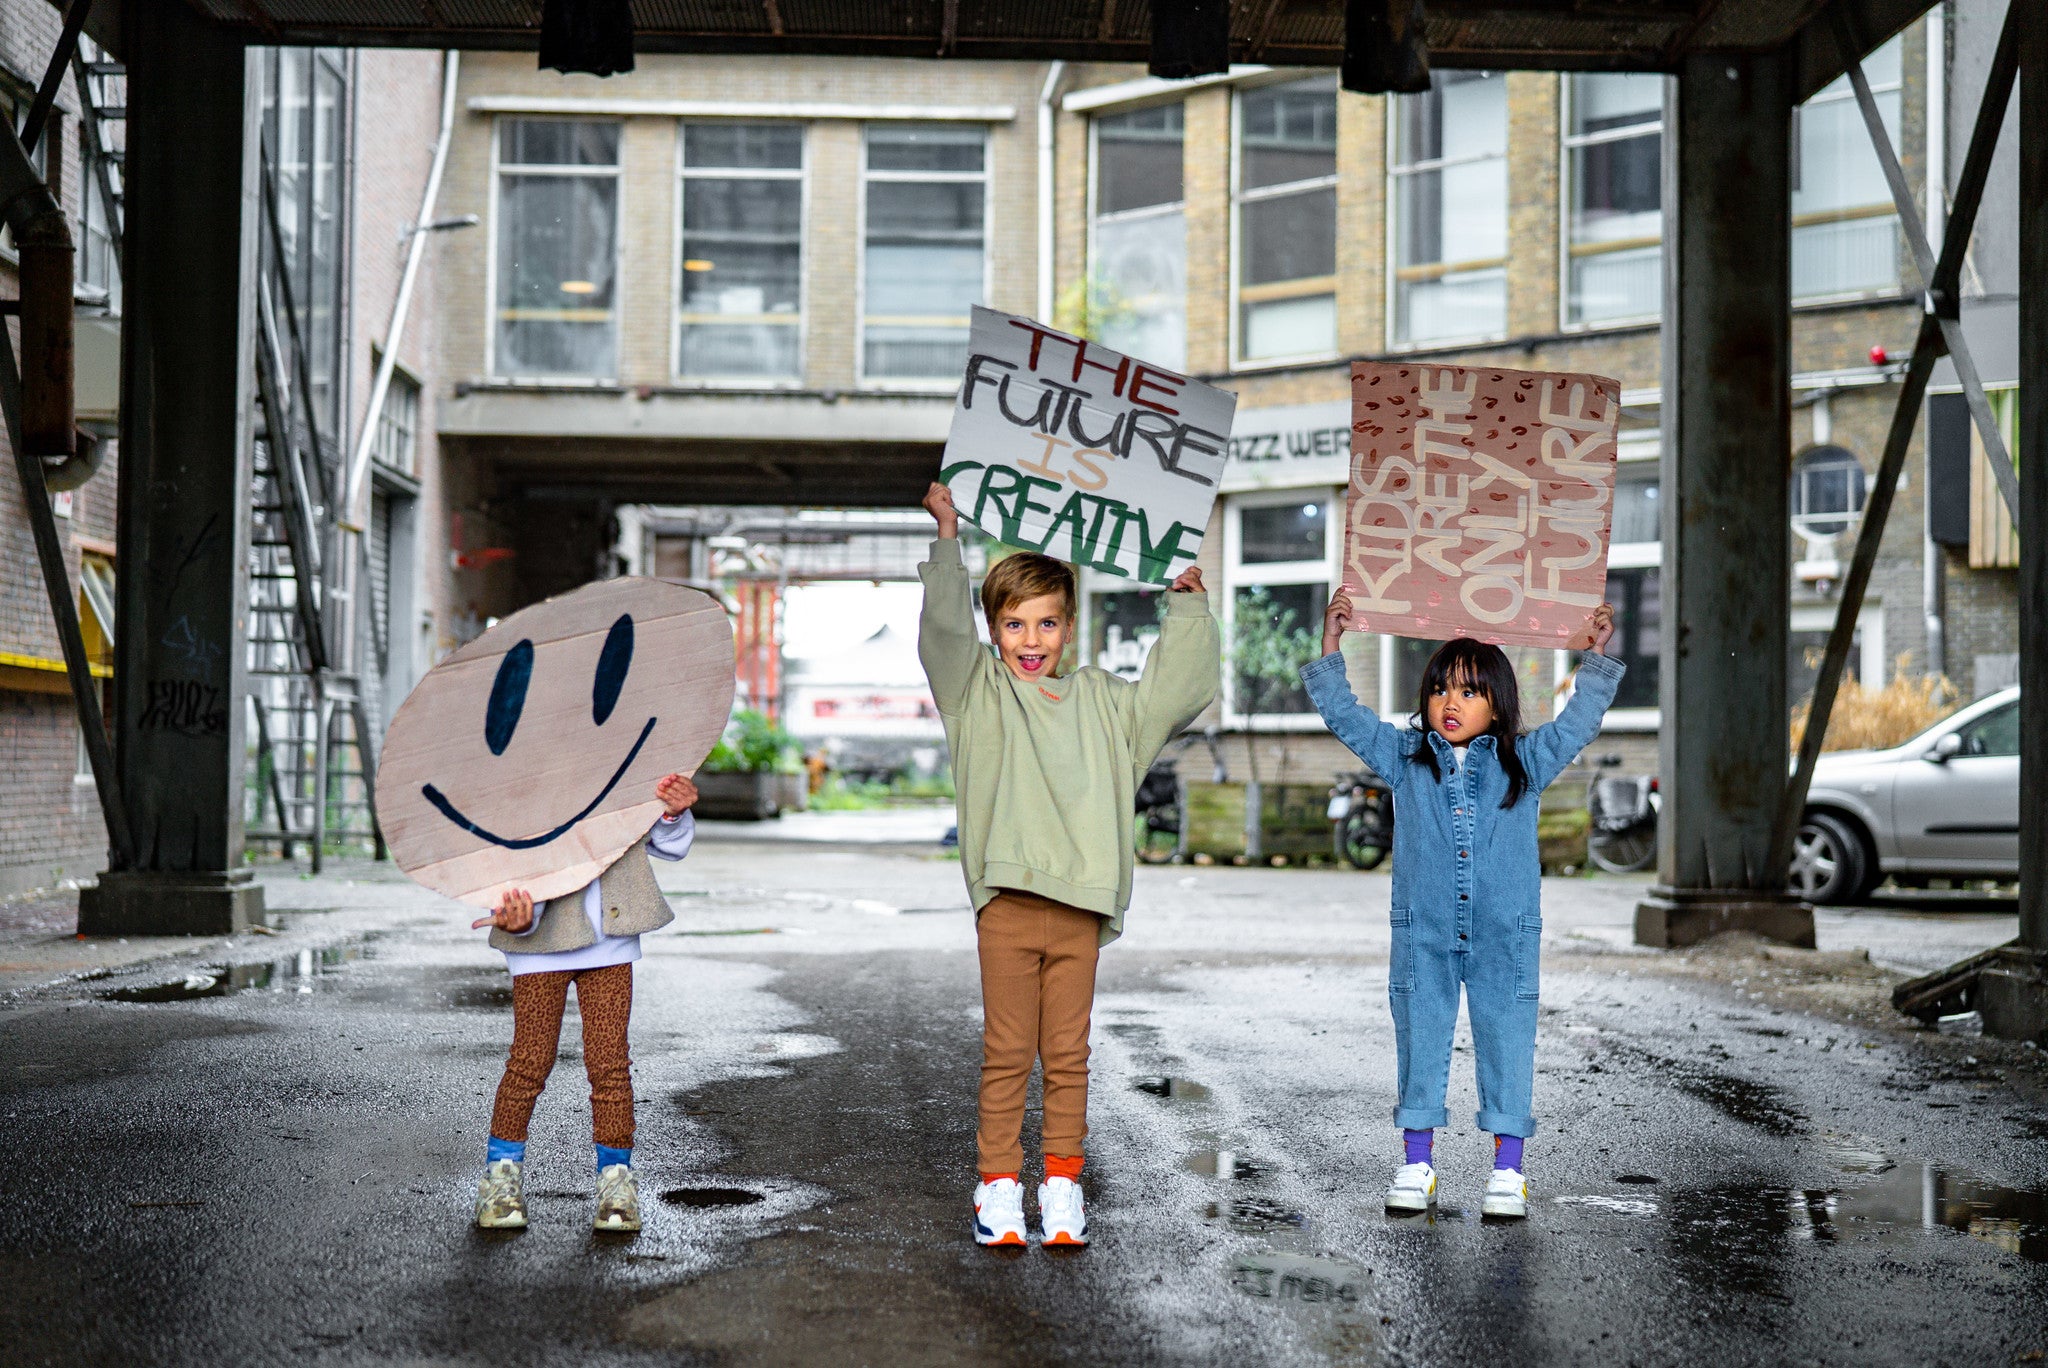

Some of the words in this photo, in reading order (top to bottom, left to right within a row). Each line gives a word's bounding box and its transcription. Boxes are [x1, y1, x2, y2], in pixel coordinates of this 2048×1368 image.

[962, 353, 1228, 487] FUTURE
[1008, 320, 1187, 416] THE
[1413, 368, 1478, 464] THE
[939, 460, 1205, 587] CREATIVE
[1016, 432, 1116, 491] IS
[1413, 464, 1470, 577] ARE
[1523, 378, 1621, 608] FUTURE
[1348, 452, 1418, 614] KIDS
[1459, 451, 1532, 624] ONLY
